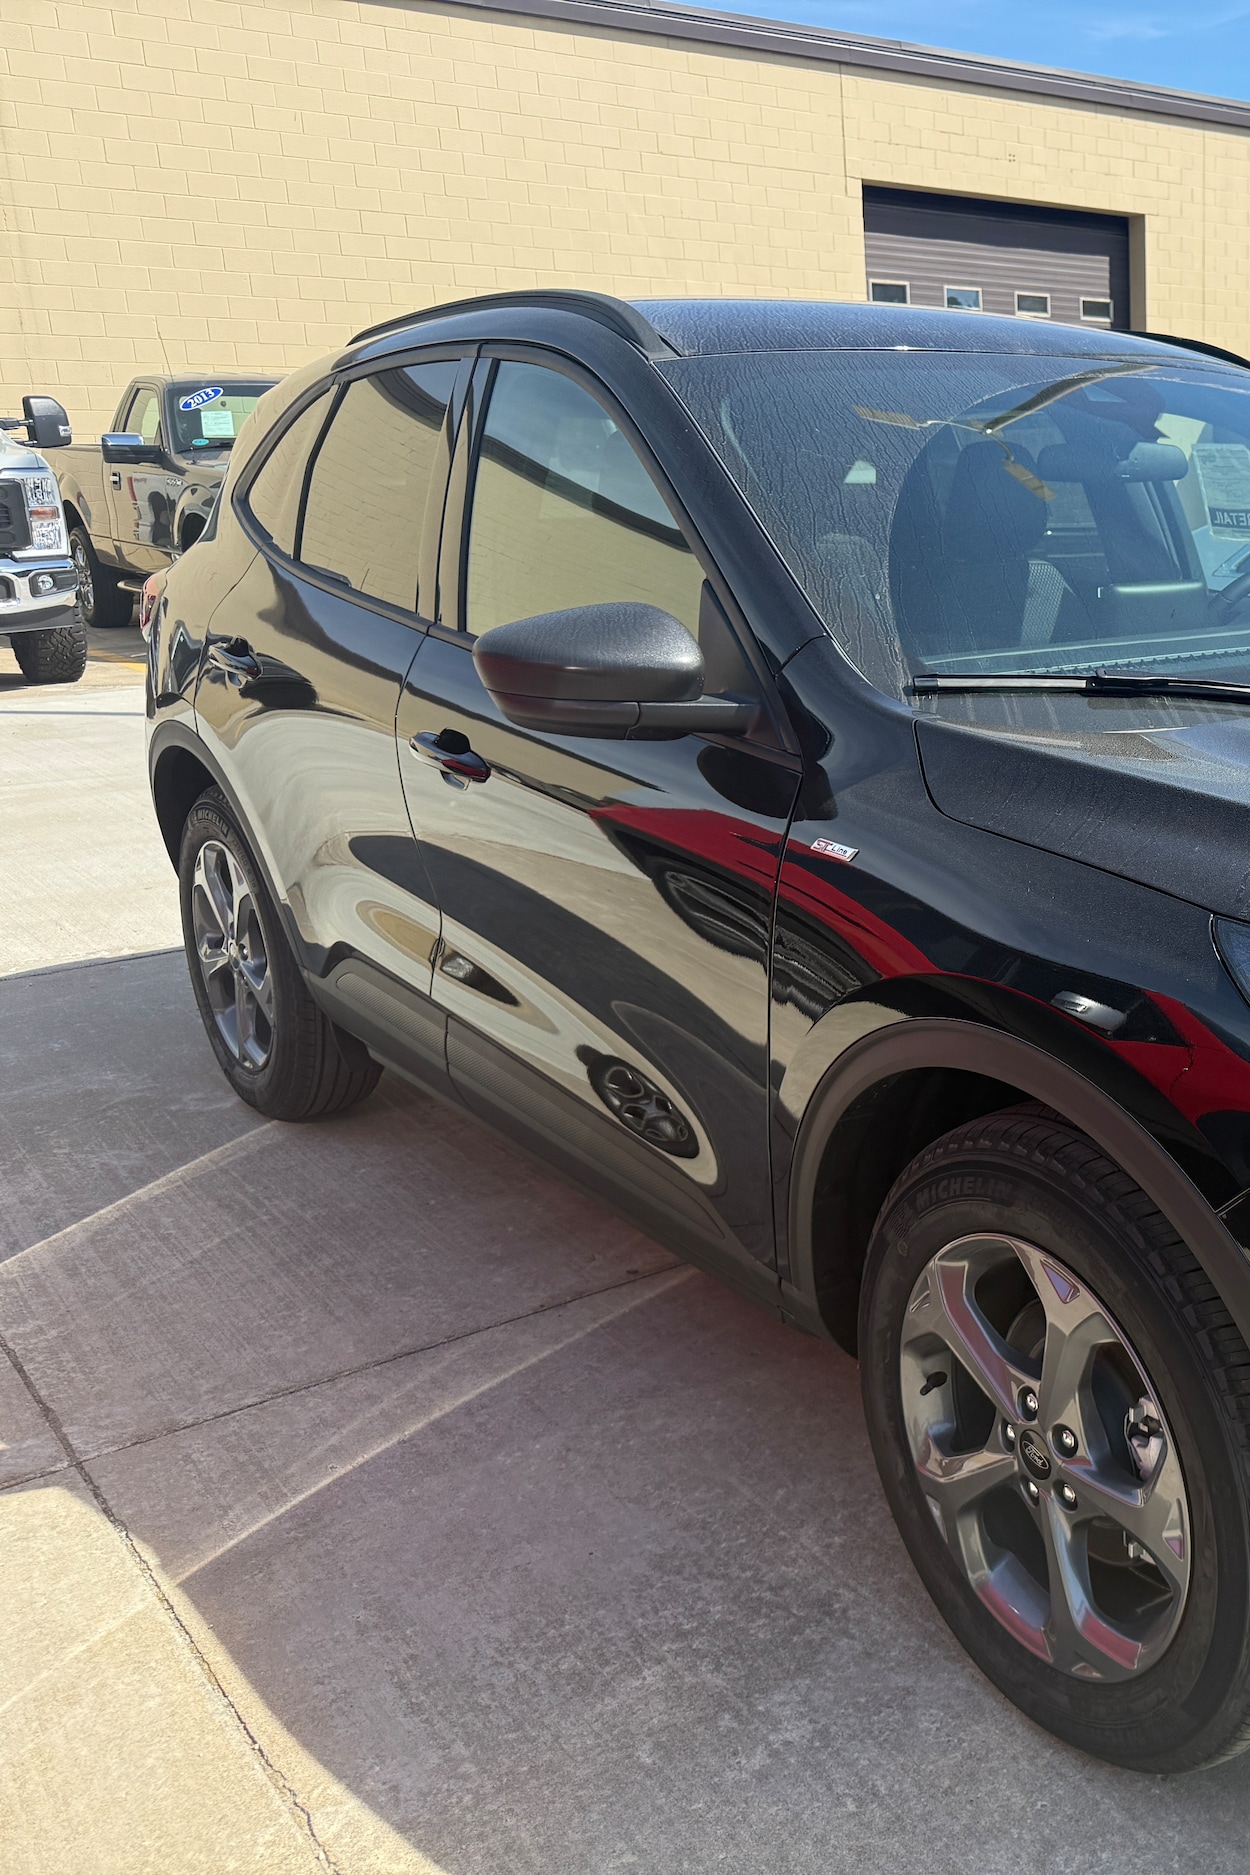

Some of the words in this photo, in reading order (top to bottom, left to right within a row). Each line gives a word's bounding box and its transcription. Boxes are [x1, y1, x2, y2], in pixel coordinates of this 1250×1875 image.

[187, 388, 215, 408] 2013
[915, 1175, 1014, 1212] MICHELIN
[1025, 1445, 1044, 1466] Ford
